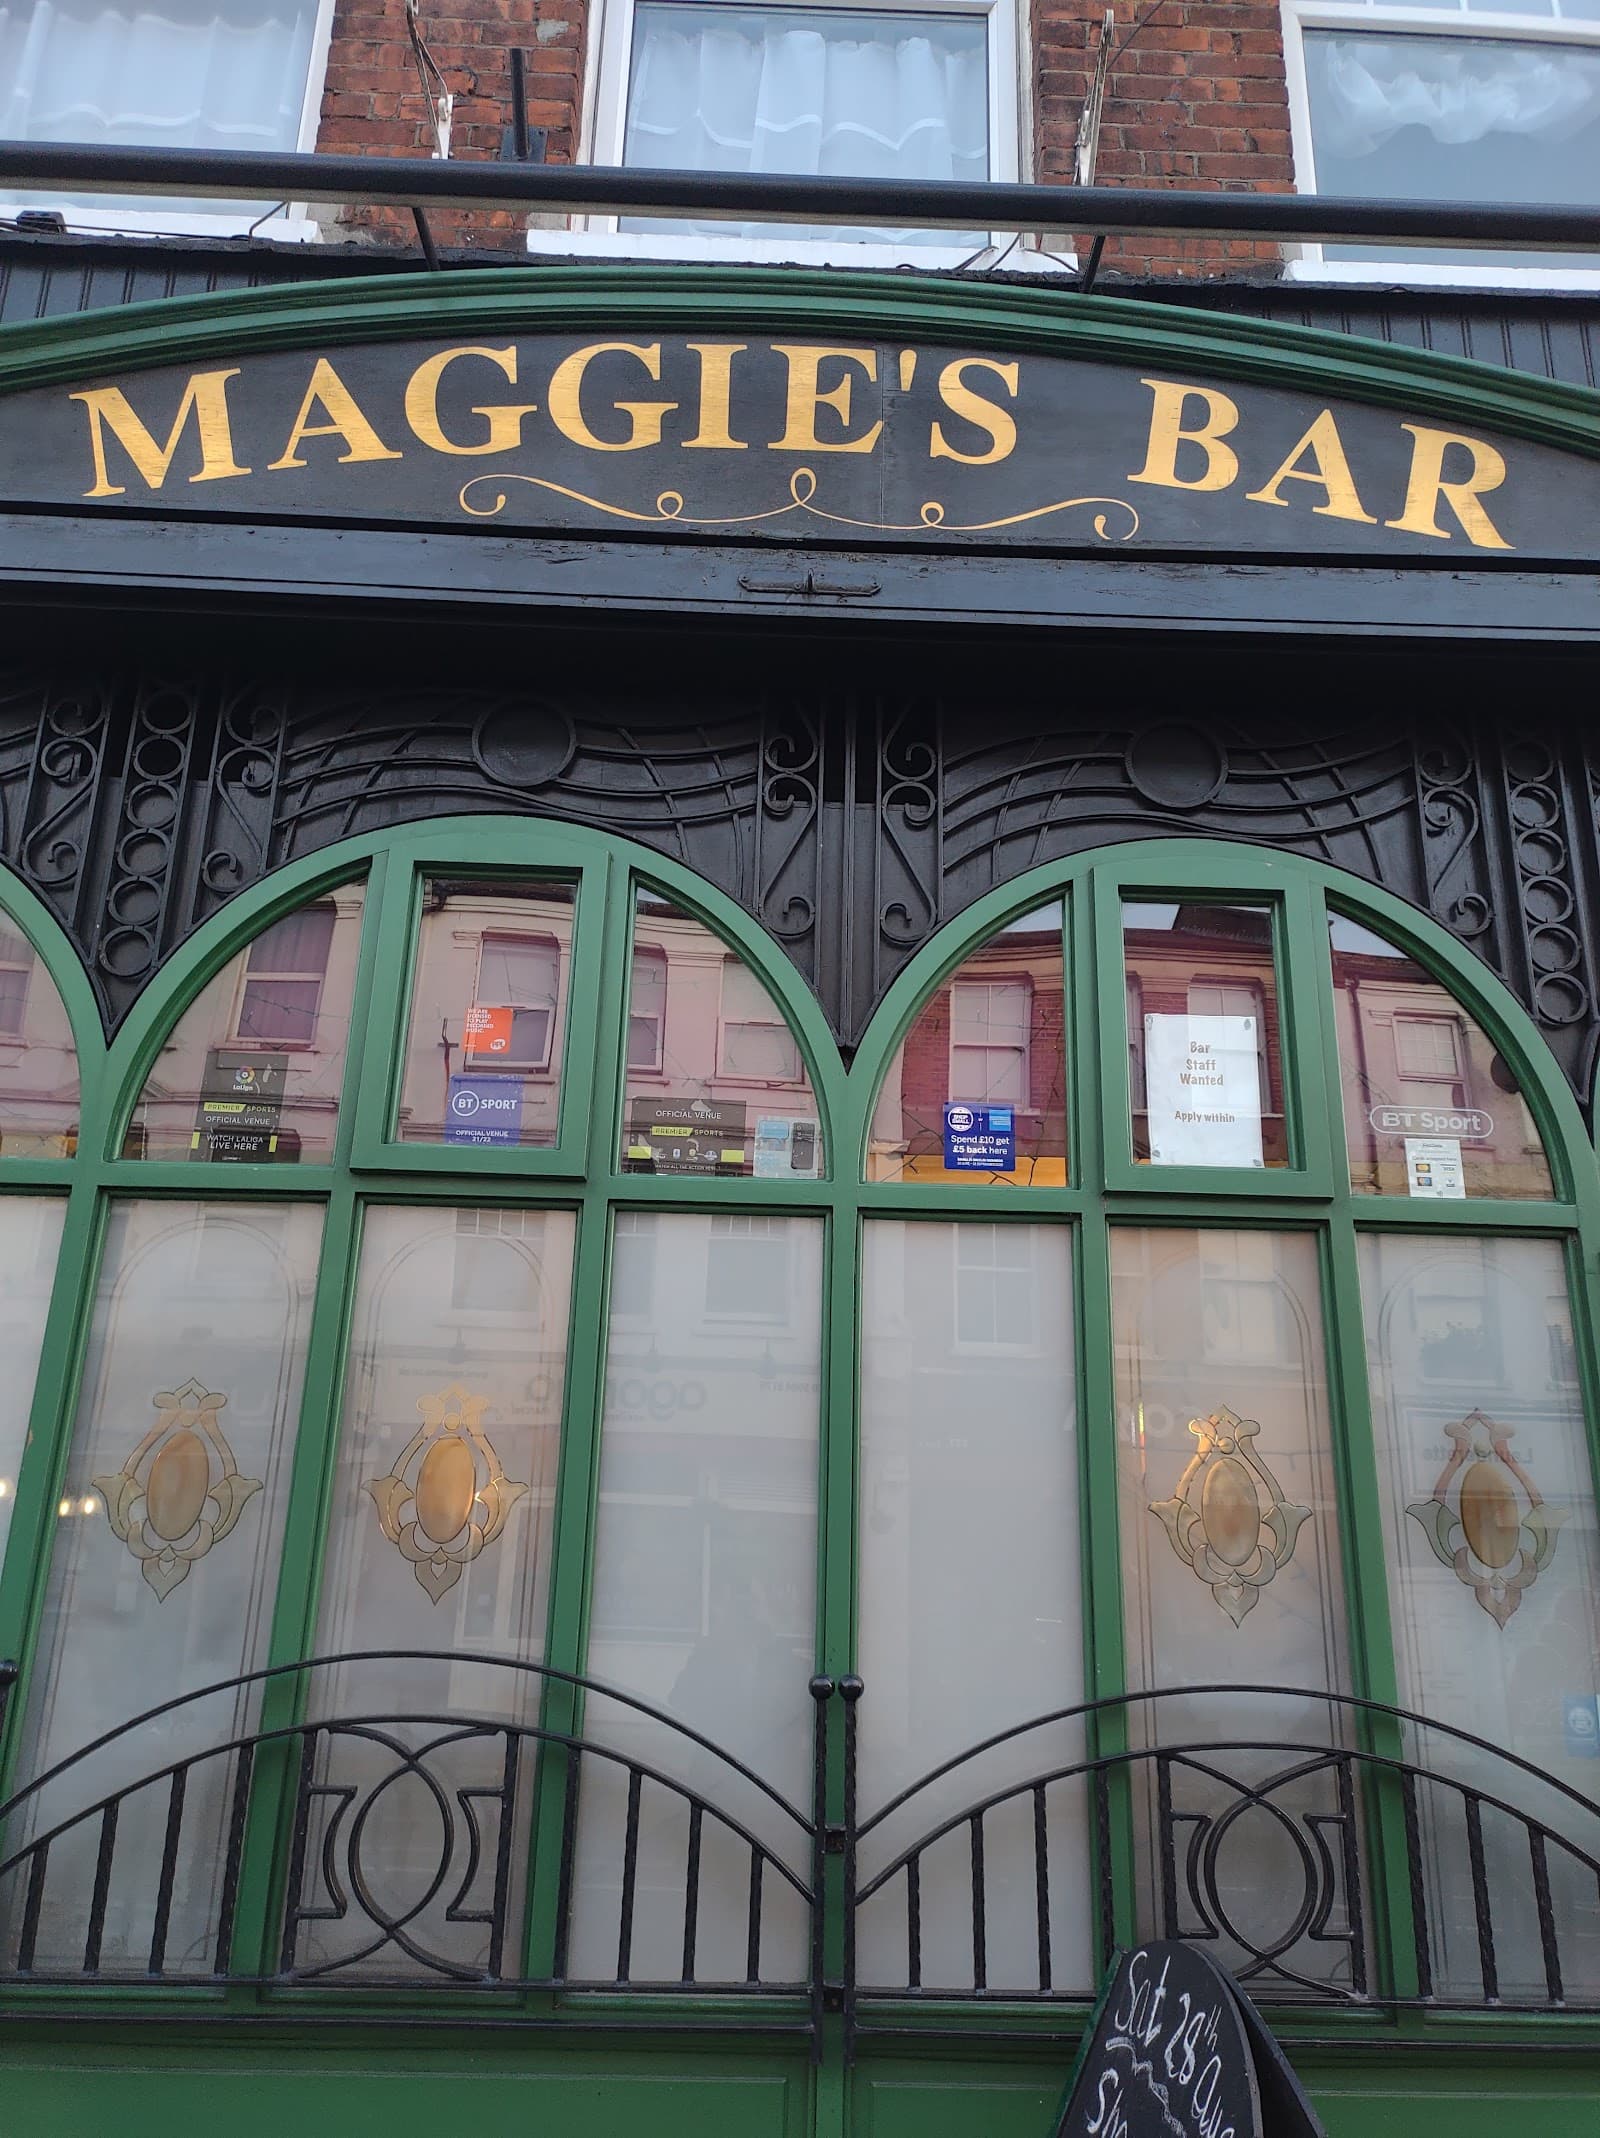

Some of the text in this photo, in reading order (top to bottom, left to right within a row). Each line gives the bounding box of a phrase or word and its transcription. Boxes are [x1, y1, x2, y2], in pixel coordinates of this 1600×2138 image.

[69, 342, 1515, 550] MAGGIE'S BAR
[1190, 1041, 1211, 1054] Bar
[1186, 1058, 1217, 1071] Staff
[1180, 1072, 1224, 1086] Wanted
[206, 1103, 241, 1111] PREMIER
[458, 1098, 518, 1110] BT SPORT
[205, 1115, 271, 1126] OFFICIAL VENUE
[655, 1109, 722, 1120] OFFICIAL VENUE
[1174, 1110, 1235, 1123] Apply within
[1382, 1111, 1481, 1132] BT Sport
[206, 1133, 235, 1142] WATCH
[655, 1127, 724, 1137] PREMIER SPORTS
[950, 1134, 1010, 1146] Spend £10 get
[210, 1142, 258, 1151] LIVE HERE
[952, 1145, 1008, 1155] £5 back here
[1114, 1950, 1171, 2048] Sat
